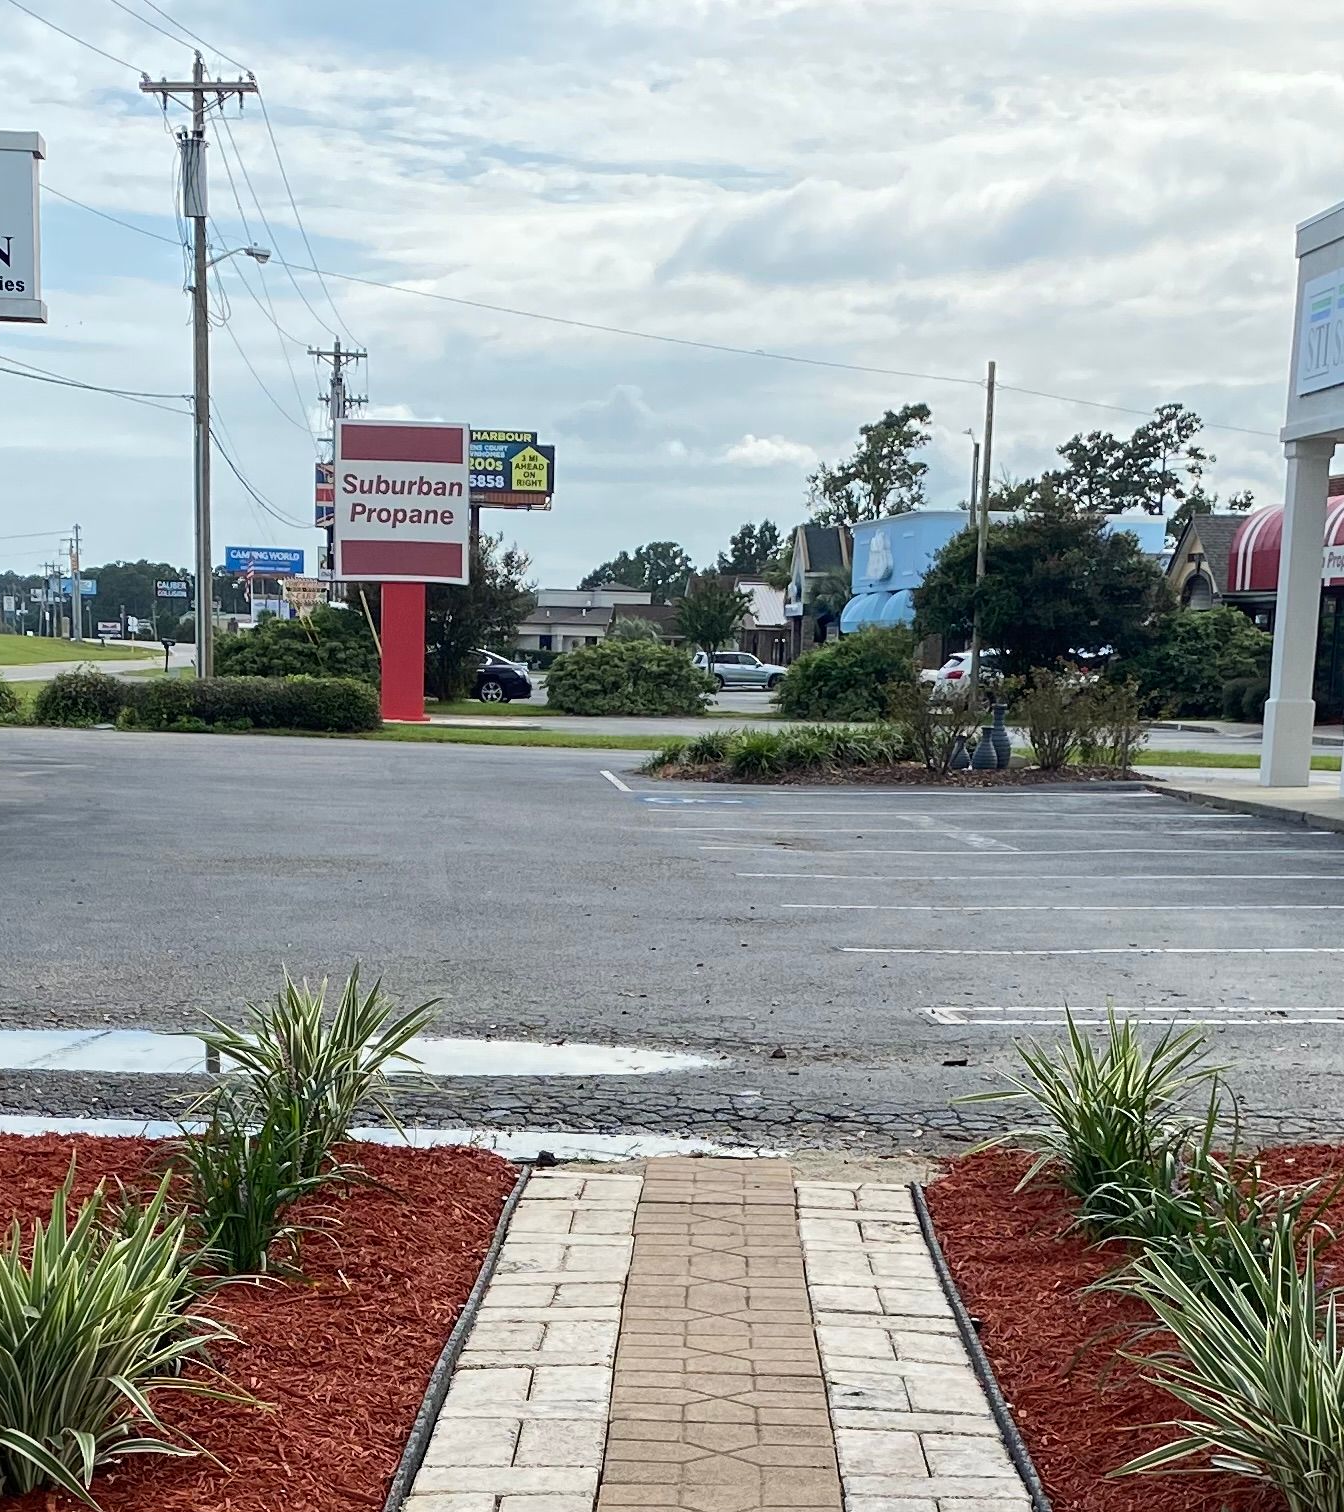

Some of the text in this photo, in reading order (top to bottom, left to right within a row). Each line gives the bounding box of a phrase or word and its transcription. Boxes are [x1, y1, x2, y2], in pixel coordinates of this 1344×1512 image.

[1306, 327, 1332, 373] STI
[472, 431, 532, 442] HARBOUR
[515, 463, 545, 471] AHEAD
[523, 471, 536, 479] ON
[341, 473, 463, 497] Suburban
[470, 475, 504, 488] 5858
[516, 479, 543, 487] RIGHT
[350, 502, 454, 528] Propane
[230, 550, 300, 561] CAMING WORLD
